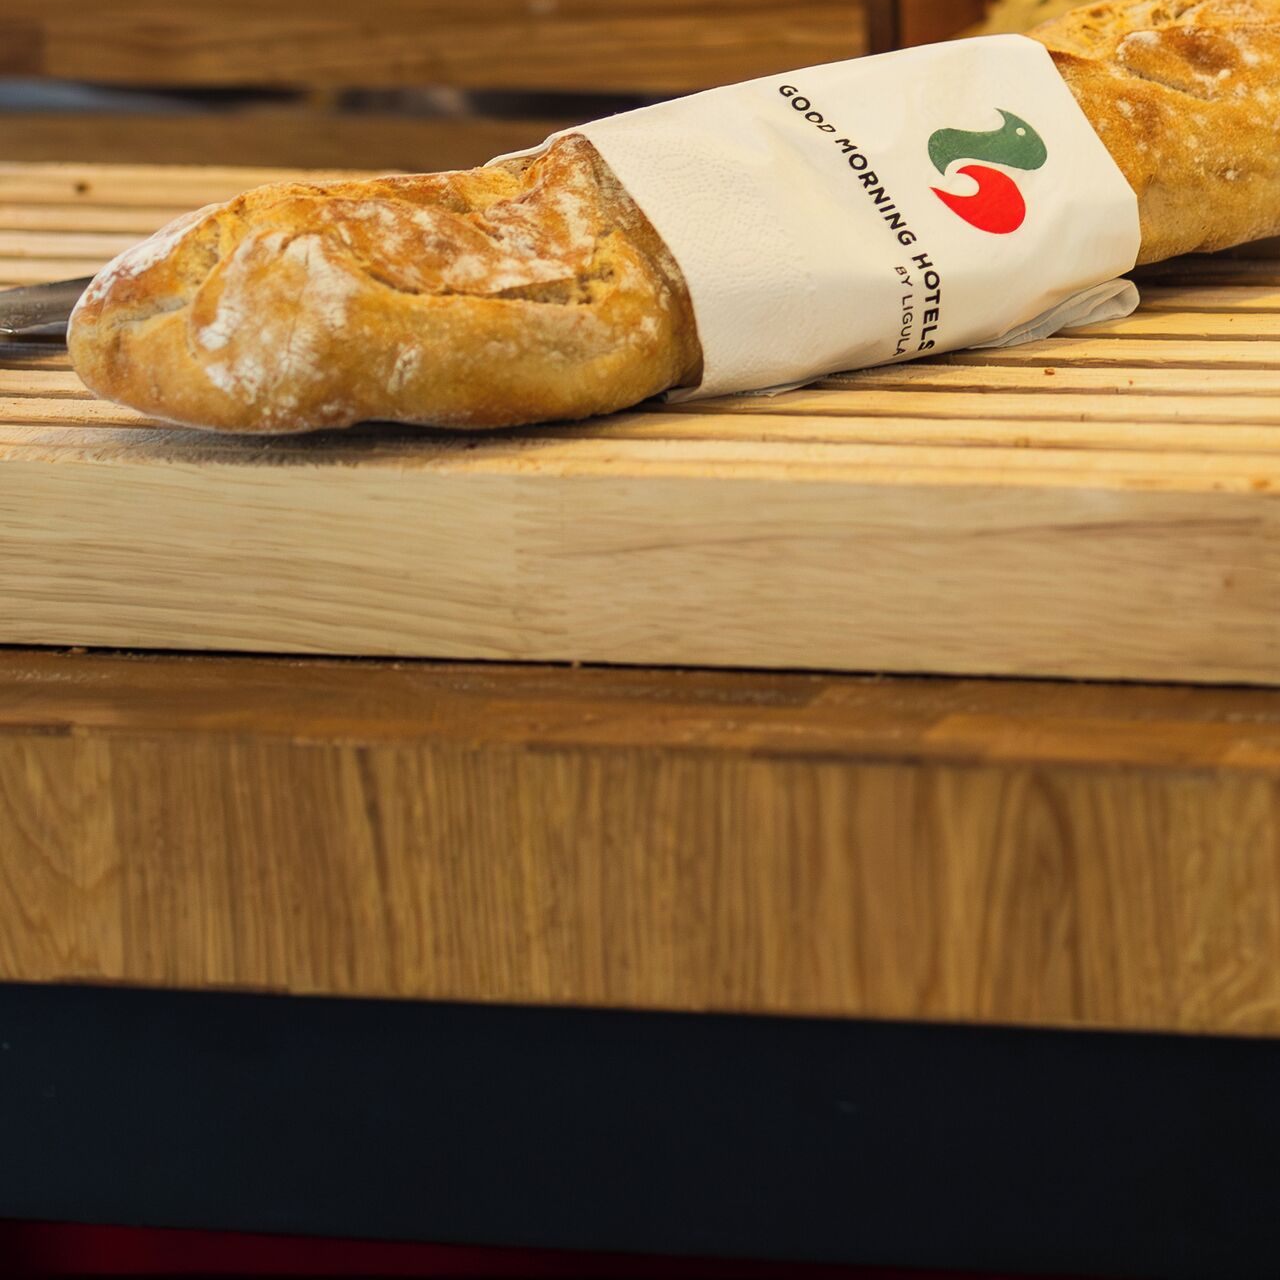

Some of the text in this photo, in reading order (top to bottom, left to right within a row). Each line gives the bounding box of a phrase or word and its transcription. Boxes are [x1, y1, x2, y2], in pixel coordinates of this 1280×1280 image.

[779, 84, 941, 351] GOOD MORNING HOTELS
[893, 266, 914, 357] BY LIGULA
